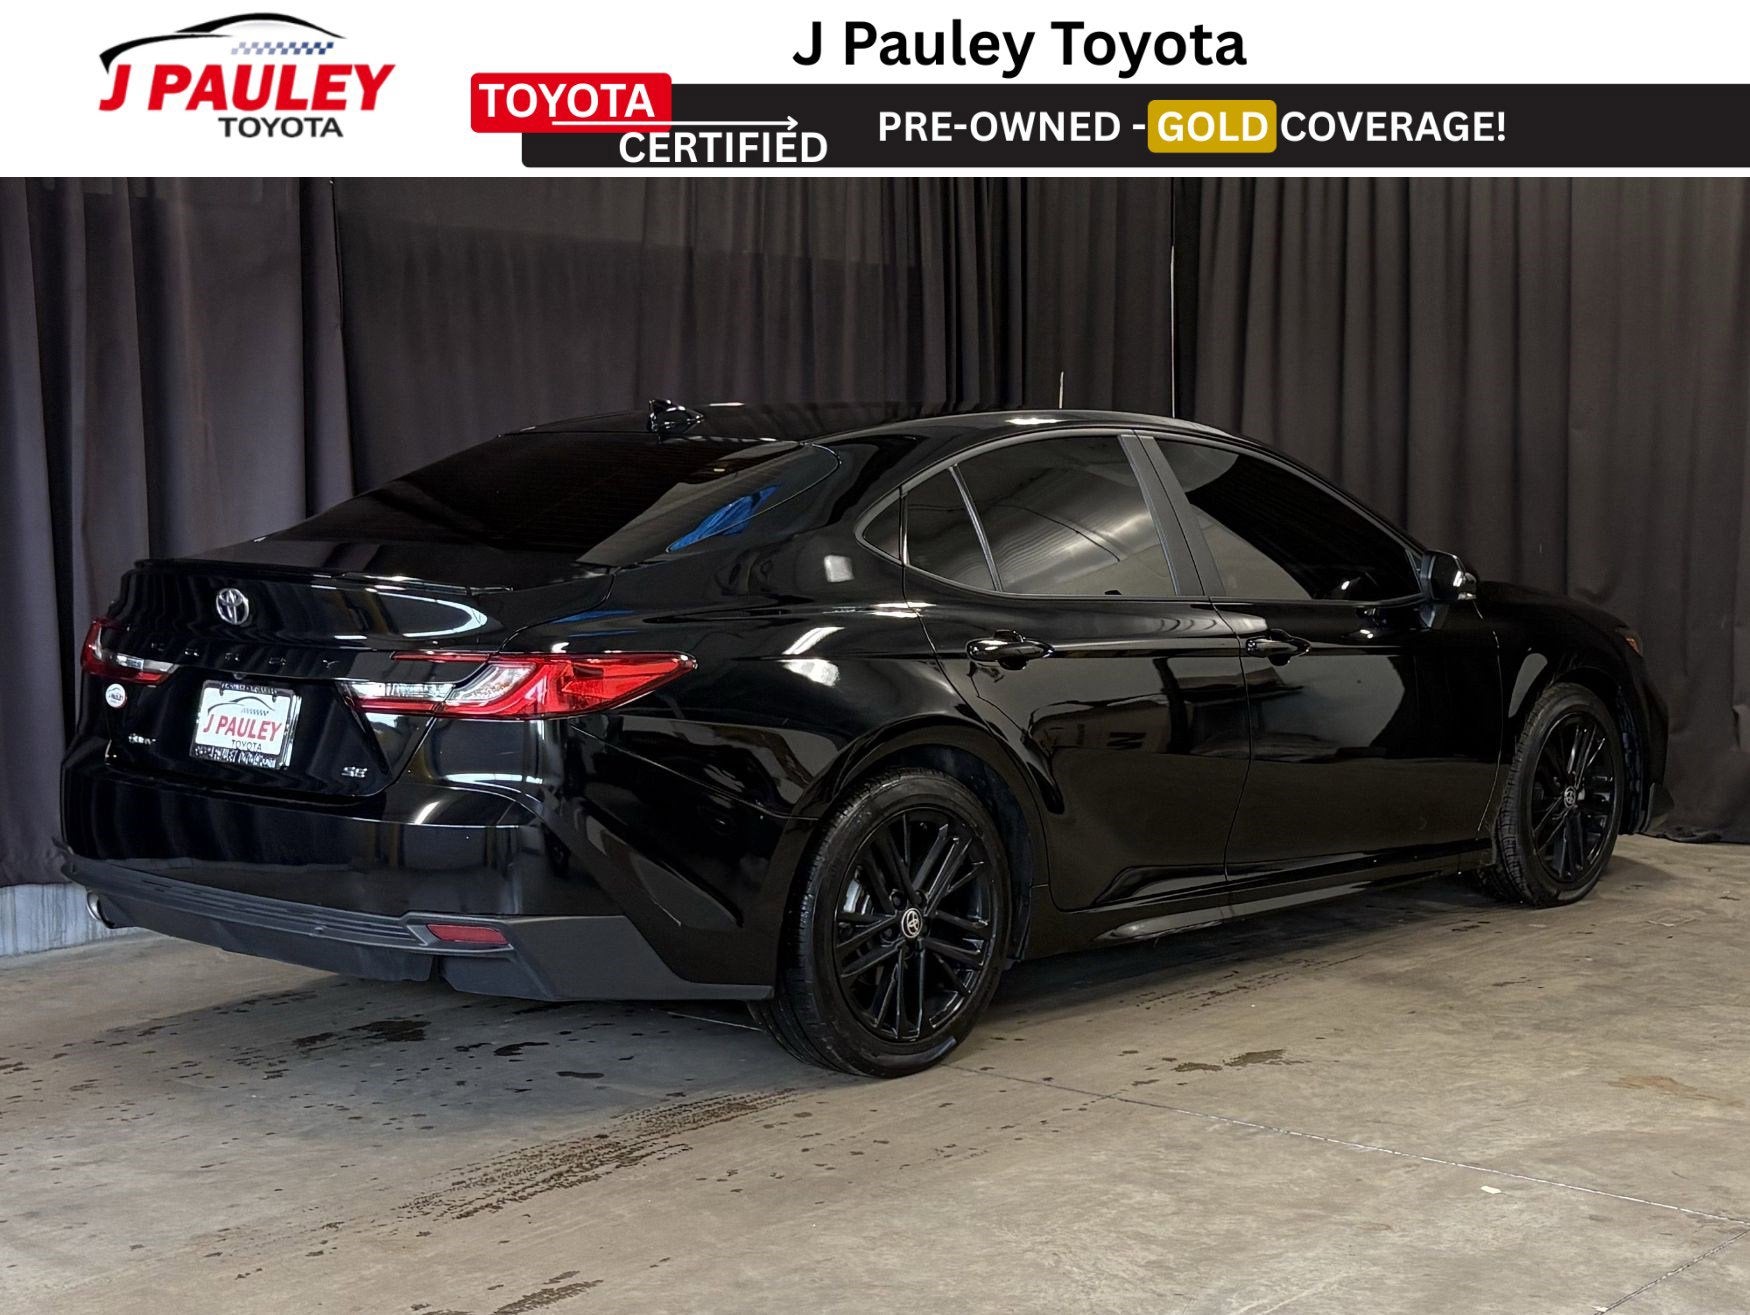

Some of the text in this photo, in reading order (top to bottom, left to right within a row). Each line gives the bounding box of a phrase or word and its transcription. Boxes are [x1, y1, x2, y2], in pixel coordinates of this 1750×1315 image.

[203, 713, 282, 742] J PAULEY
[231, 739, 262, 751] TOYOTA
